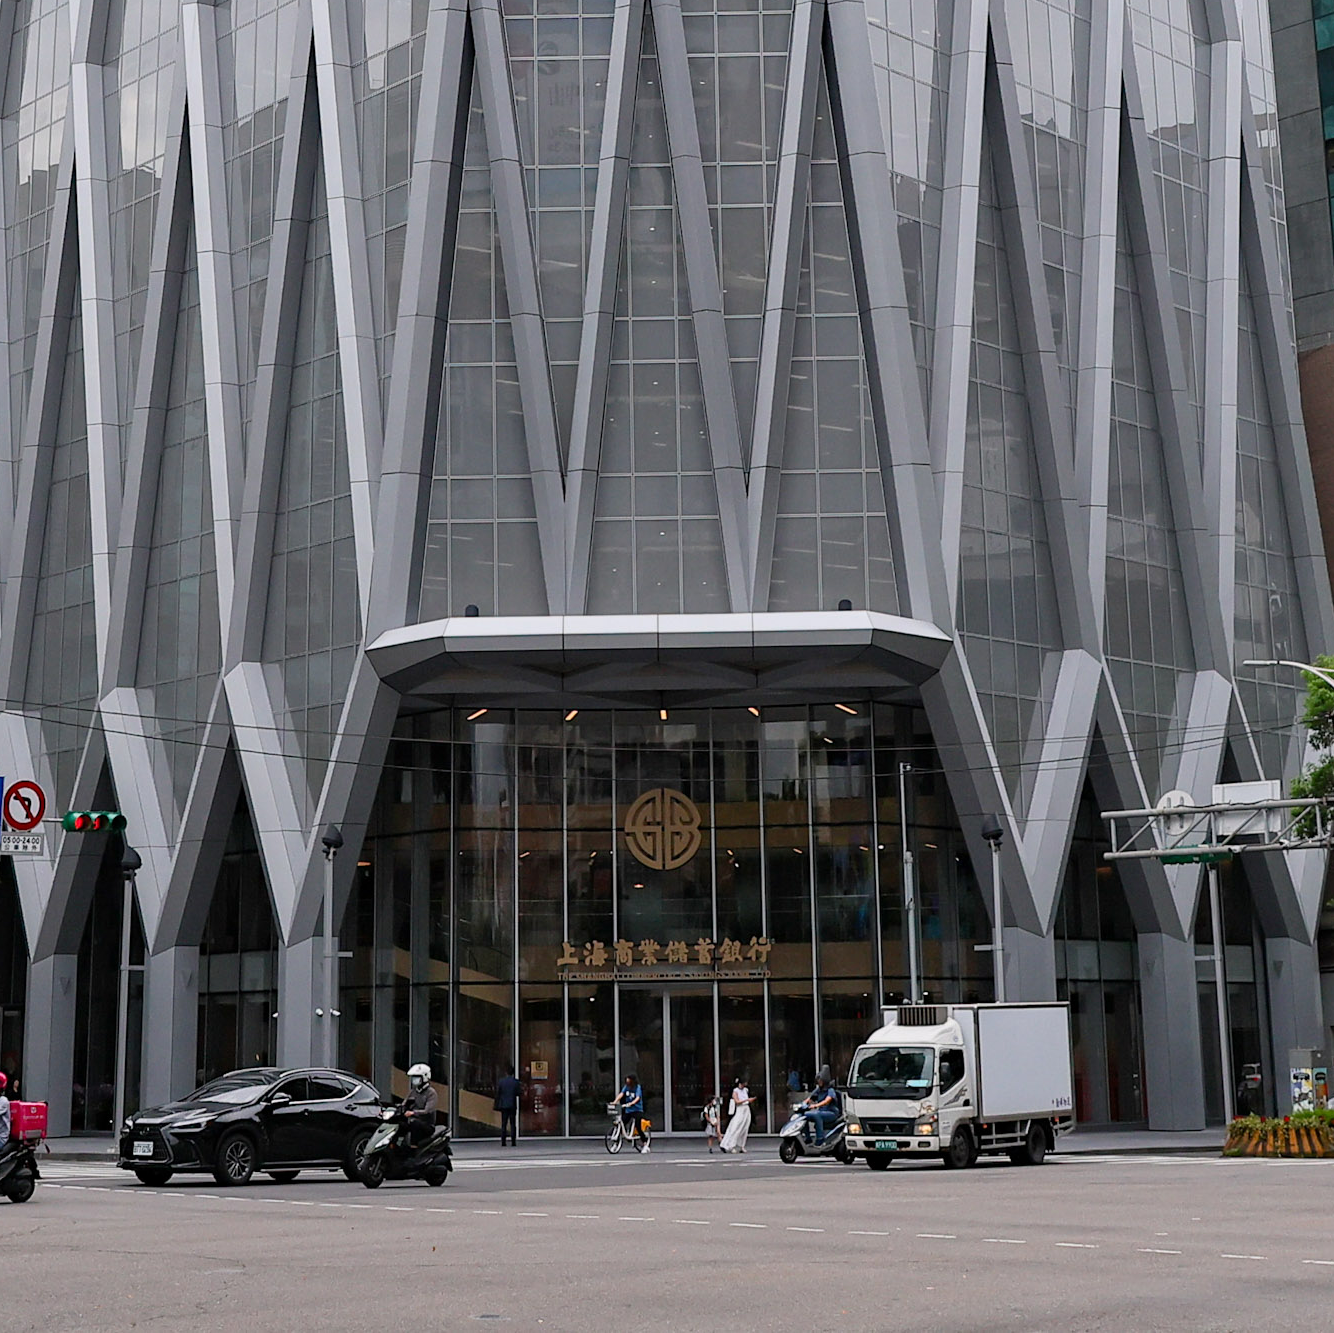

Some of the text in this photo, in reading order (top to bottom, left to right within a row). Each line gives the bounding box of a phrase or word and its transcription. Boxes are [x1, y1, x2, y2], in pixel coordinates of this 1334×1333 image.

[557, 936, 772, 967] 上海商業儲蓄銀行
